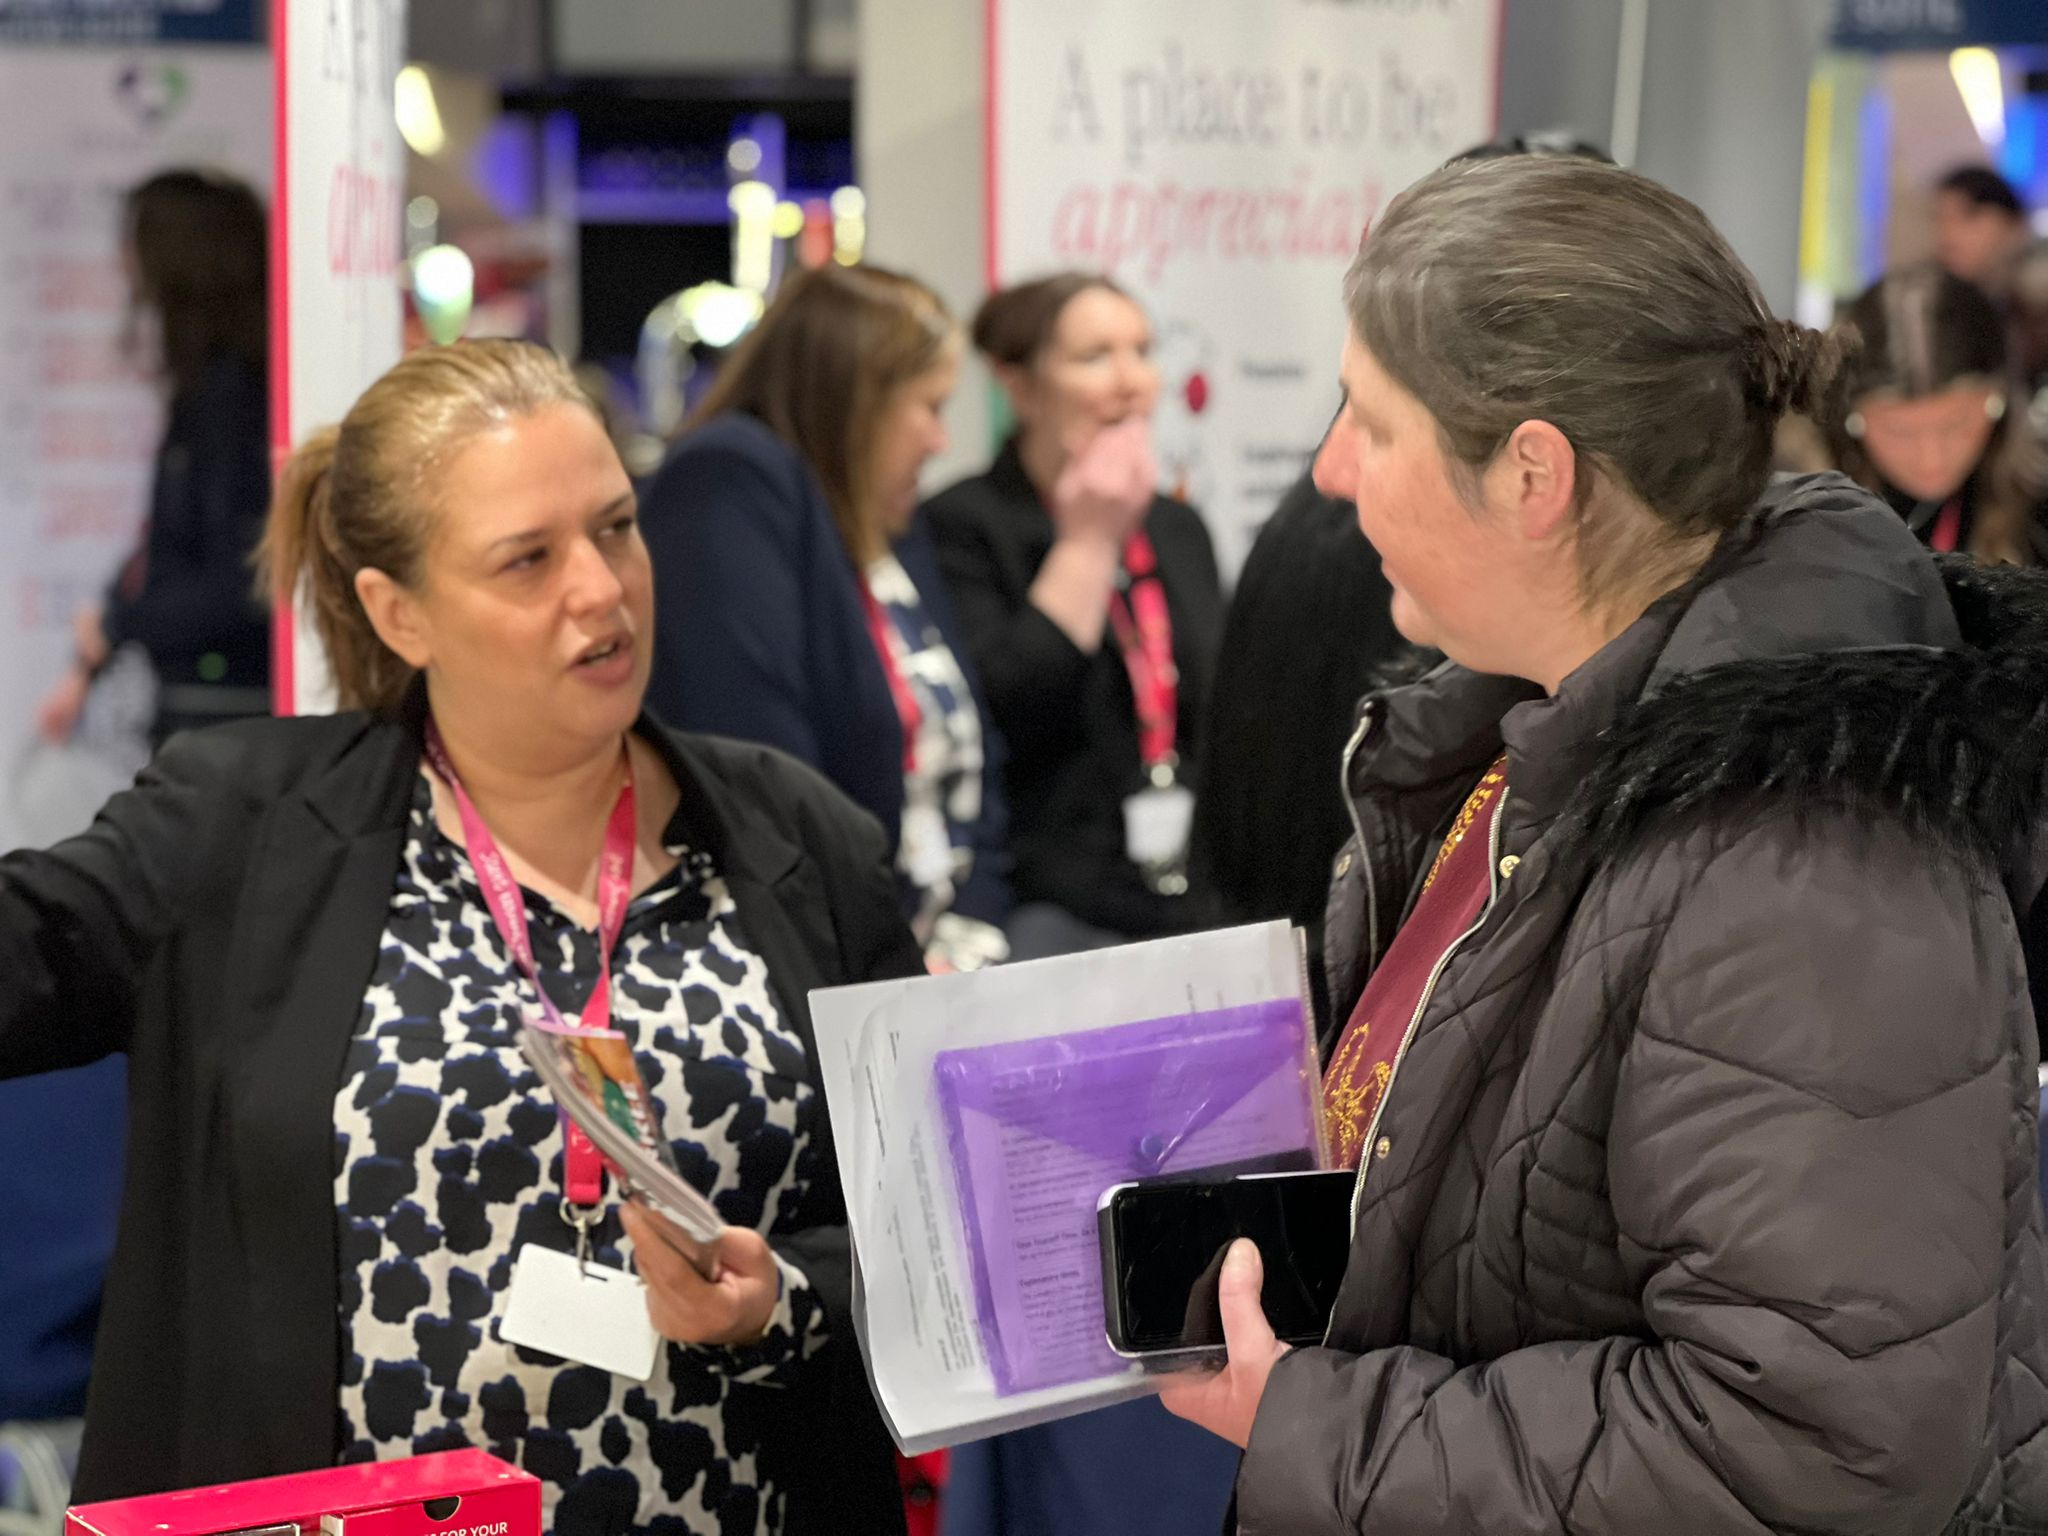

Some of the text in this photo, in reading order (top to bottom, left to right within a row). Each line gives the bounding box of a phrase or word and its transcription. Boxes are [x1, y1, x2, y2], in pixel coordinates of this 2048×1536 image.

[1051, 40, 1461, 167] A place to be
[470, 1522, 508, 1536] YOUR
